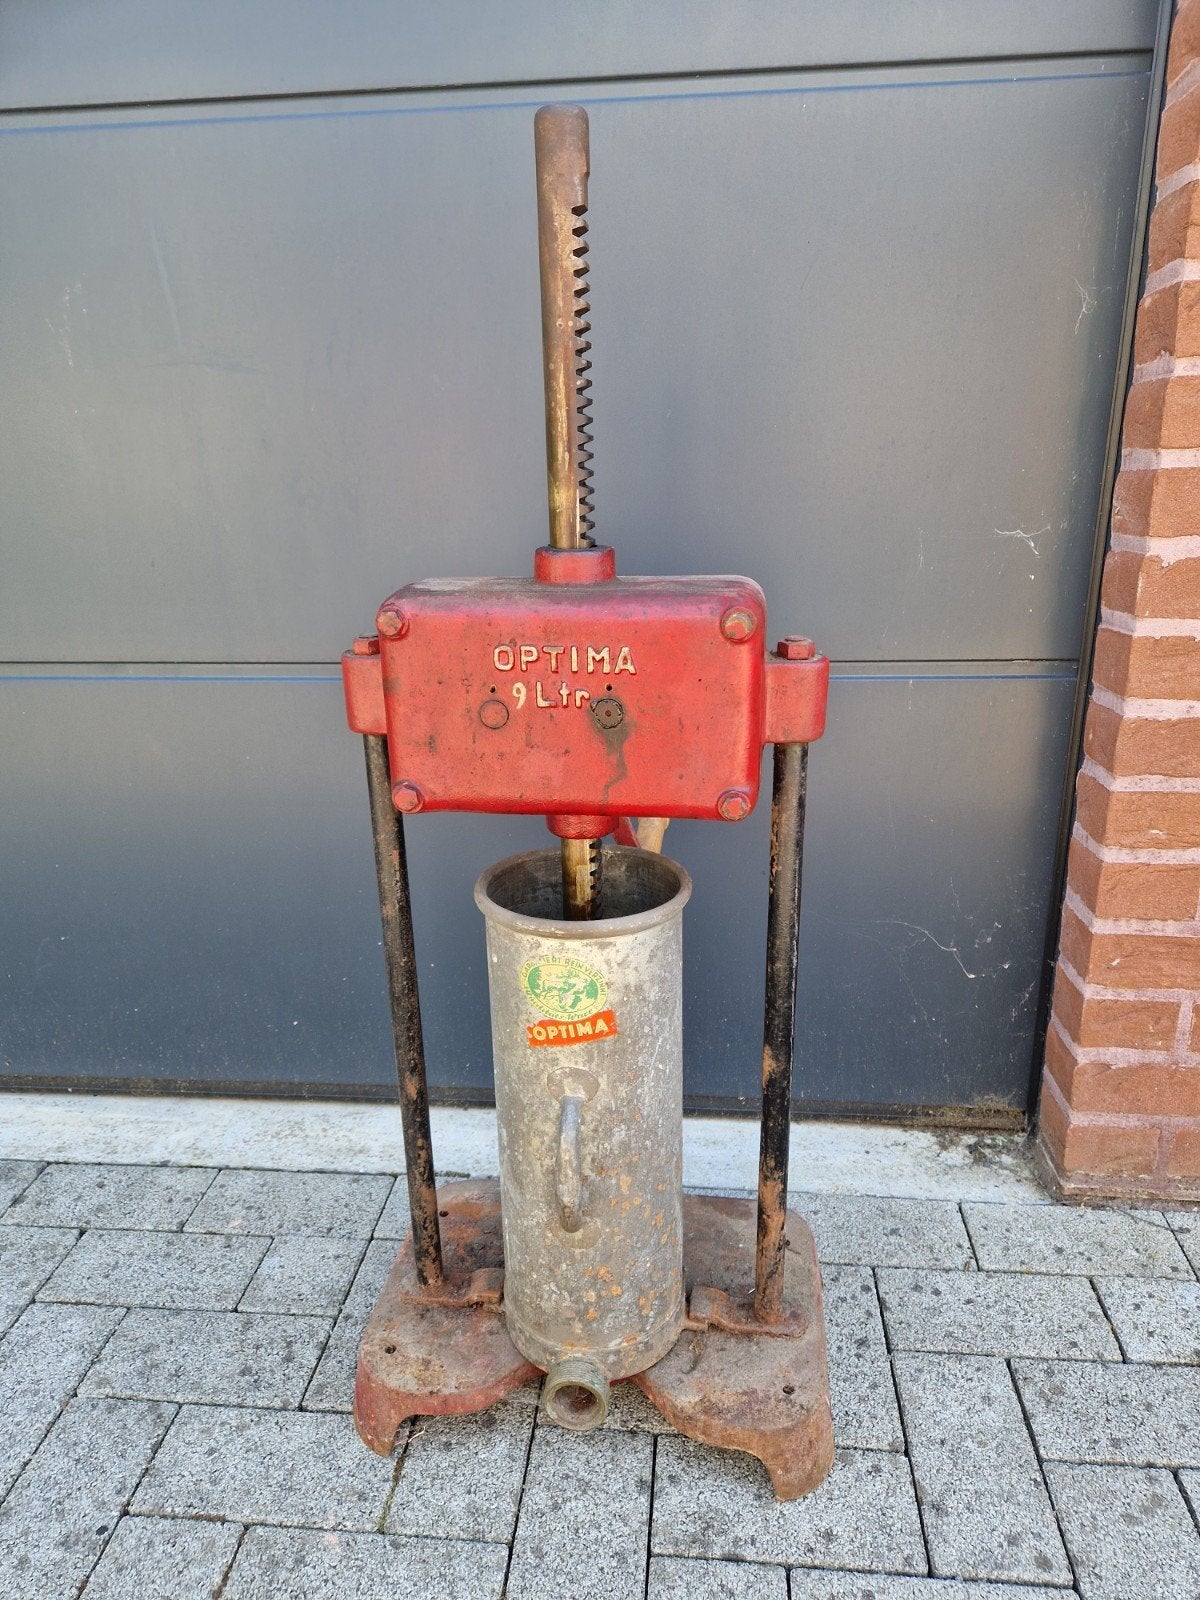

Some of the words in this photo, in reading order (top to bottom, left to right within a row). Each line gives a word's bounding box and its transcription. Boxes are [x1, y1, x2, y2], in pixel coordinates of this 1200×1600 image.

[493, 645, 637, 675] OPTIMA
[512, 681, 527, 710] 9
[565, 958, 584, 969] REIN
[532, 1018, 609, 1041] OPTIMA
